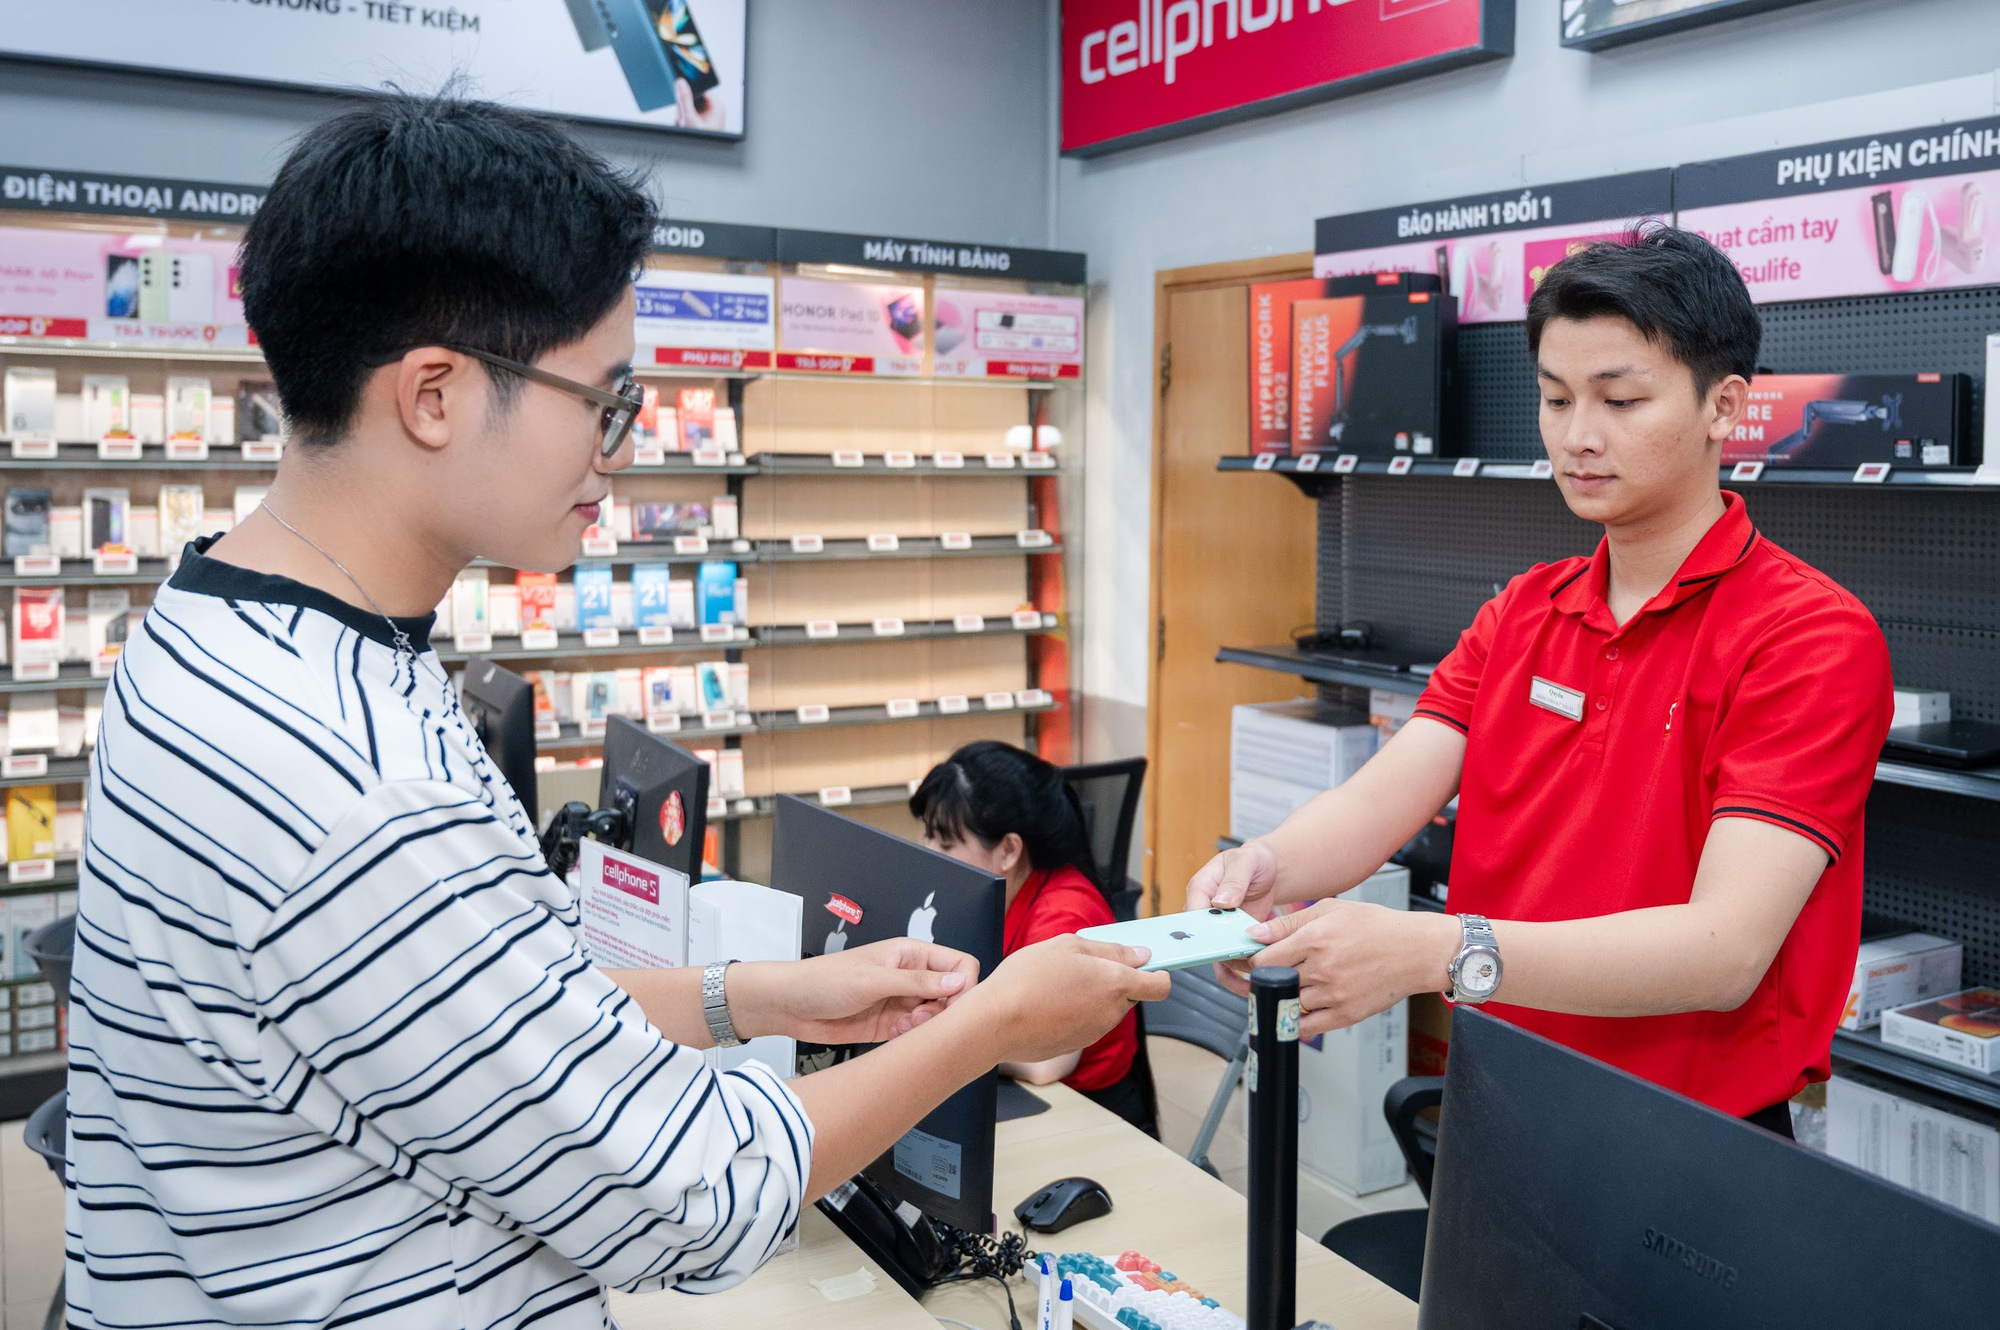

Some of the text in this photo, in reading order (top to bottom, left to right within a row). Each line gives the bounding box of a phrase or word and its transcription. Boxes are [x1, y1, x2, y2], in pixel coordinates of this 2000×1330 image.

[421, 5, 480, 35] KIỆM
[1080, 0, 1350, 85] cellpho
[1776, 126, 2000, 186] PHỤ KIỆN CHÍNH
[3, 173, 77, 206] ĐIỆN
[82, 180, 173, 213] THOẠI
[1397, 190, 1551, 237] BẢO HÀNH 1 ĐỔI 1
[1747, 215, 1795, 246] cầm
[1801, 217, 1839, 243] tay
[864, 238, 1011, 271] MÁY TÍNH BẢNG
[1735, 256, 1802, 285] sulife
[783, 303, 837, 319] HONOR
[582, 585, 609, 609] 21
[640, 583, 667, 607] 21
[604, 863, 657, 897] cellphone S
[1643, 1226, 1739, 1288] SAMSUNG
